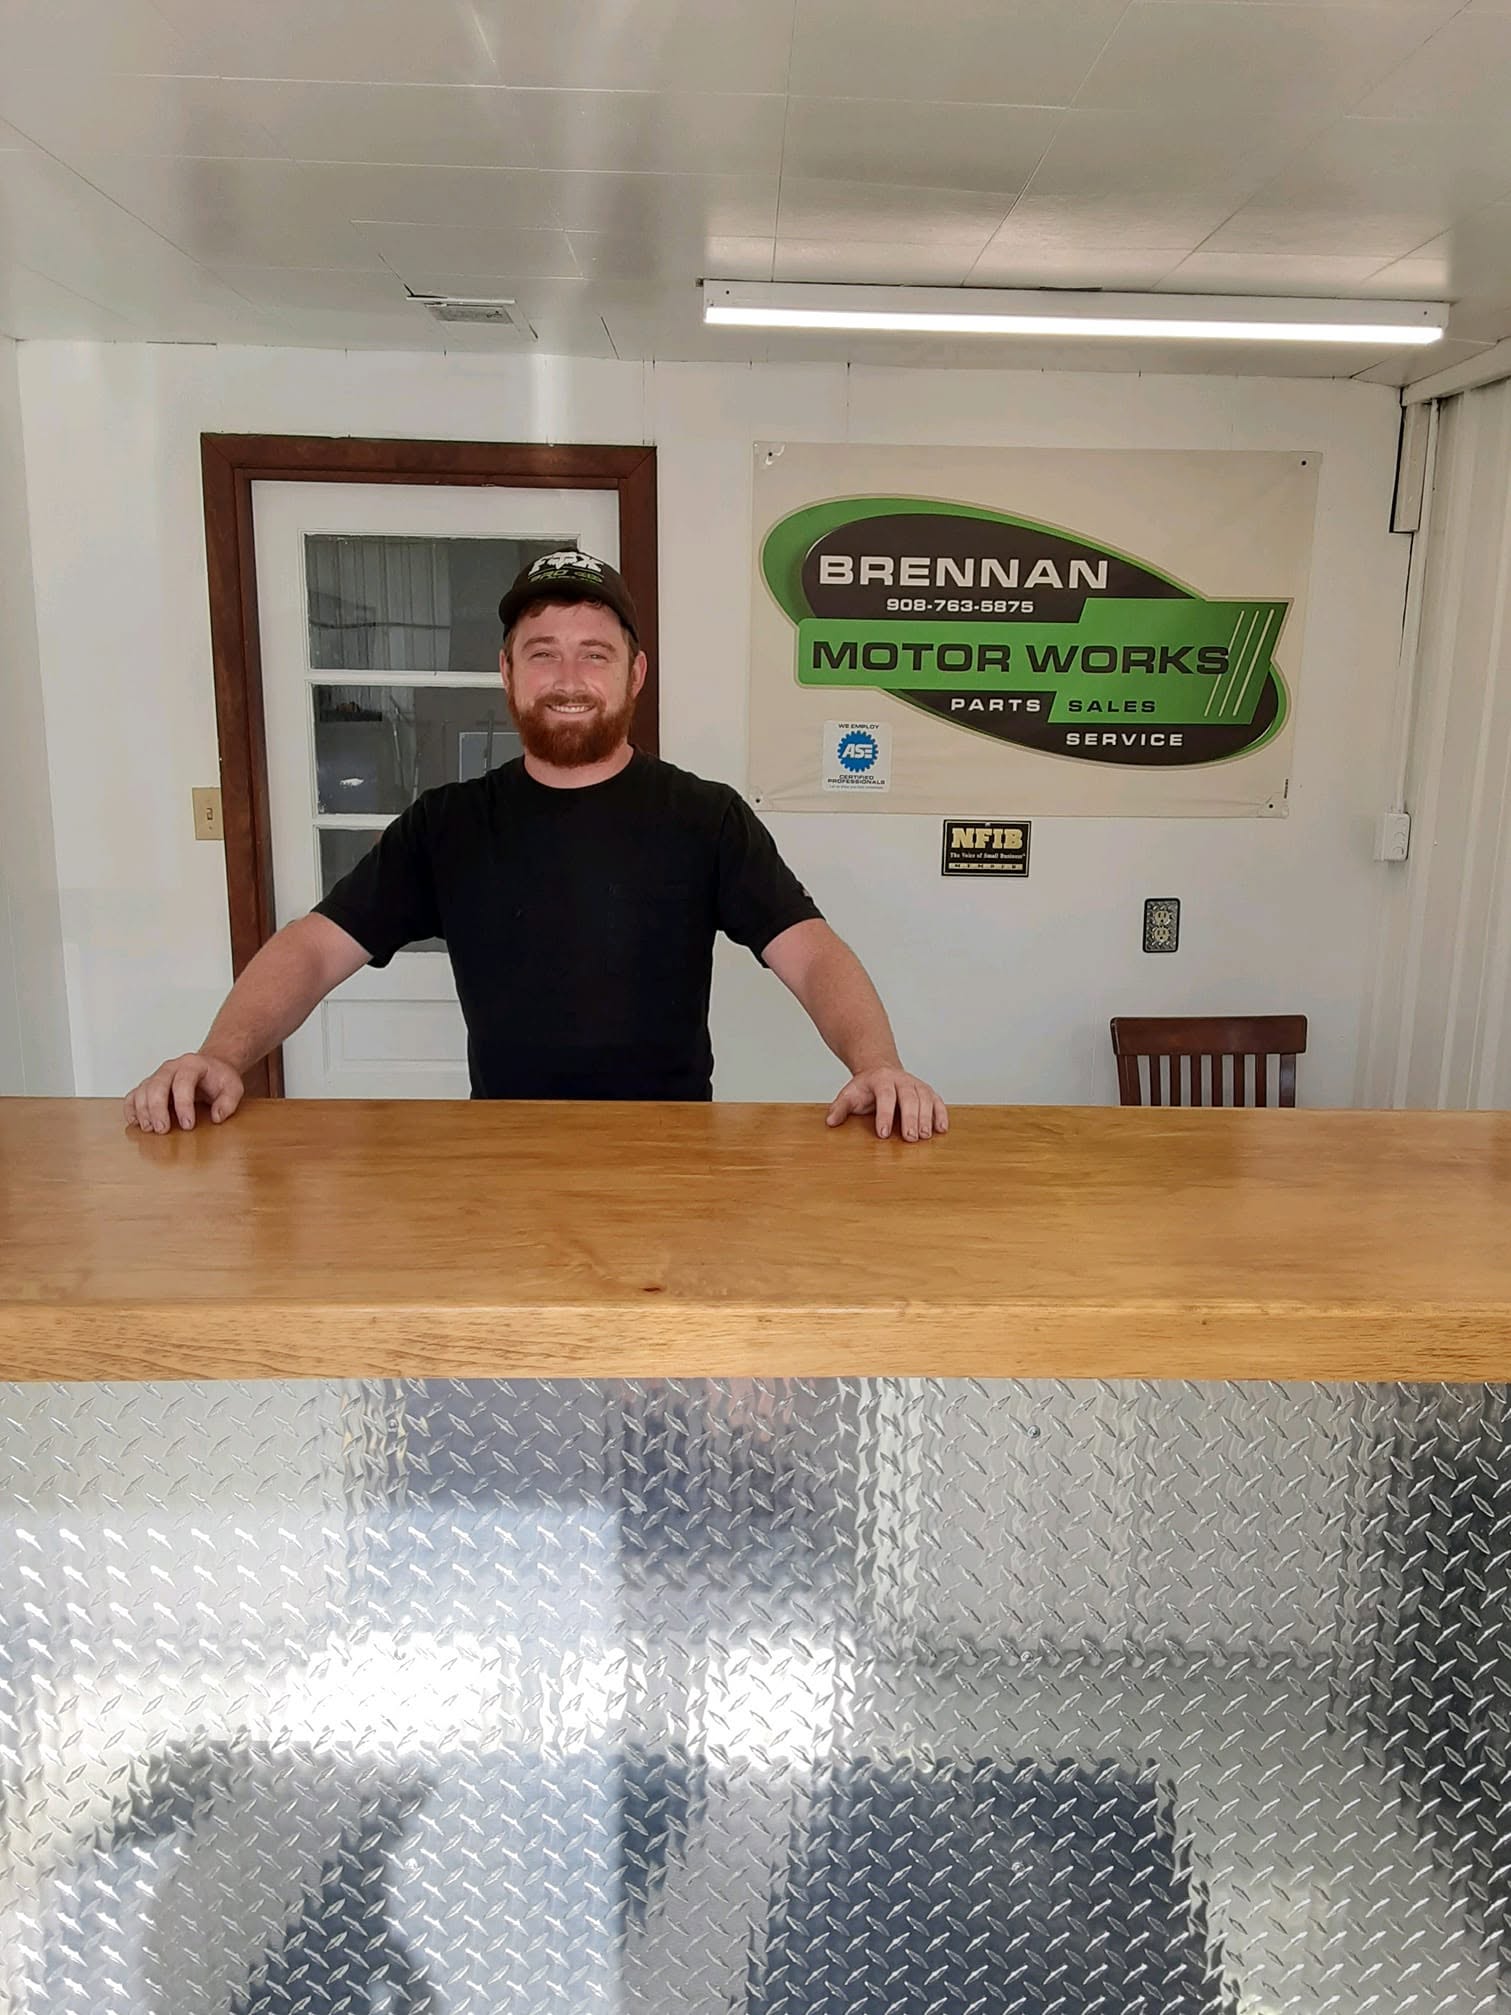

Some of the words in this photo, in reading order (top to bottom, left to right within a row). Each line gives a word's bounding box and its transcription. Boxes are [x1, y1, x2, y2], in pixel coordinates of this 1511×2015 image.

[819, 555, 1108, 589] BRENNAN
[886, 598, 1034, 614] 908-763-5875
[812, 641, 1010, 673] MOTOR
[1025, 645, 1229, 675] WORKS
[951, 698, 1041, 712] PARTS
[1068, 700, 1156, 713] SALES
[1066, 733, 1183, 747] SERVICE
[841, 743, 873, 759] ASE
[951, 827, 1023, 849] NFIB
